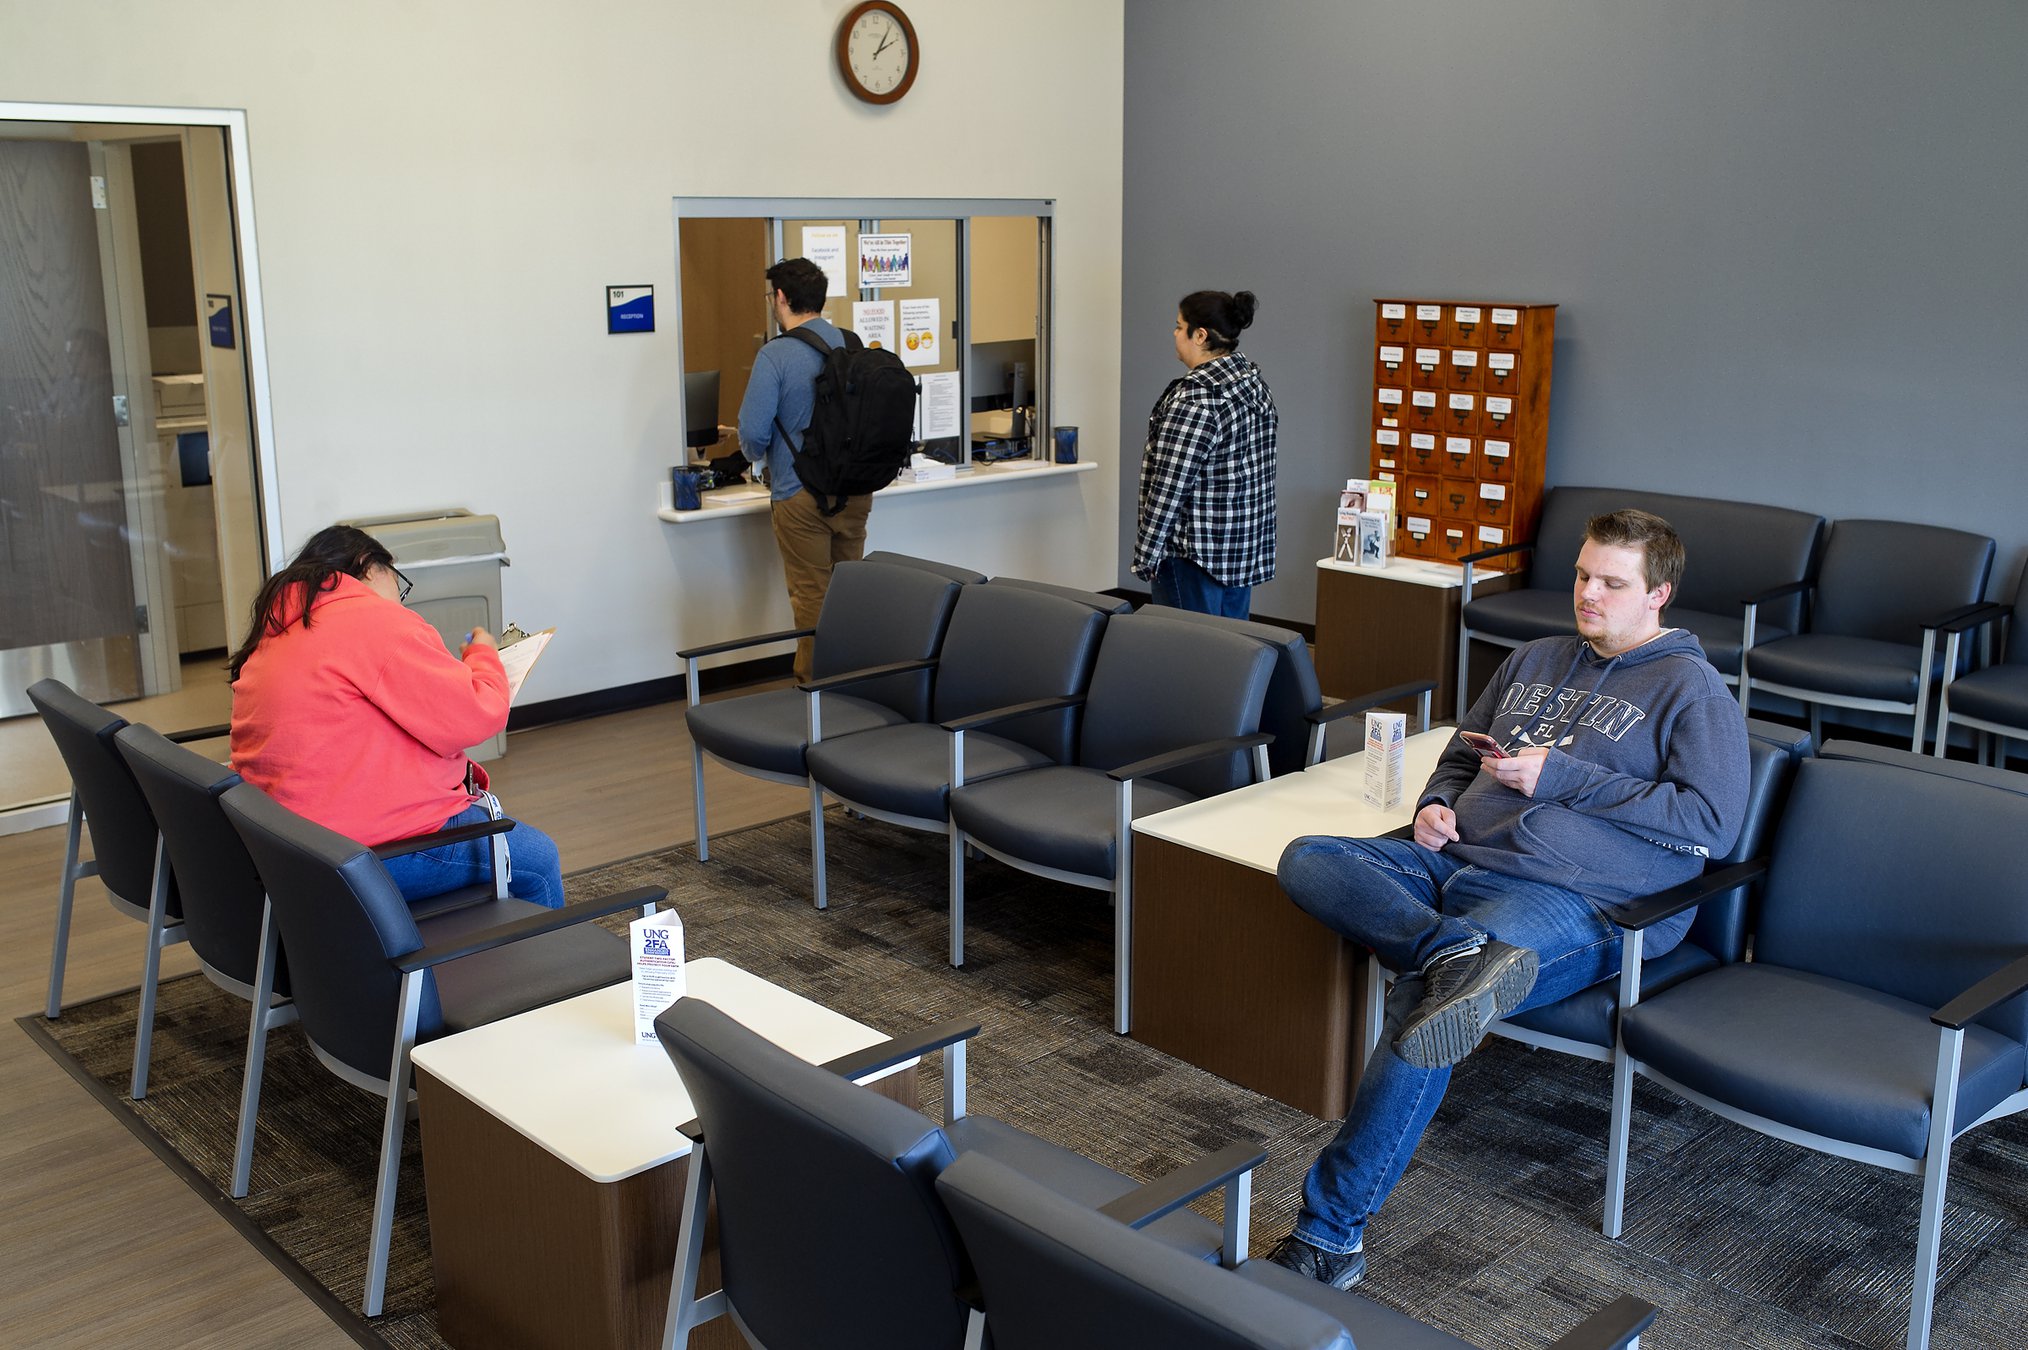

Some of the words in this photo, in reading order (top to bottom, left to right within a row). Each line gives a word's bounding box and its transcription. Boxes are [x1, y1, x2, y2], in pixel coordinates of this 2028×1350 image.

[1495, 682, 1646, 742] DESTIN
[1533, 723, 1554, 738] FL
[643, 929, 669, 939] UNG
[645, 940, 668, 949] 2FA
